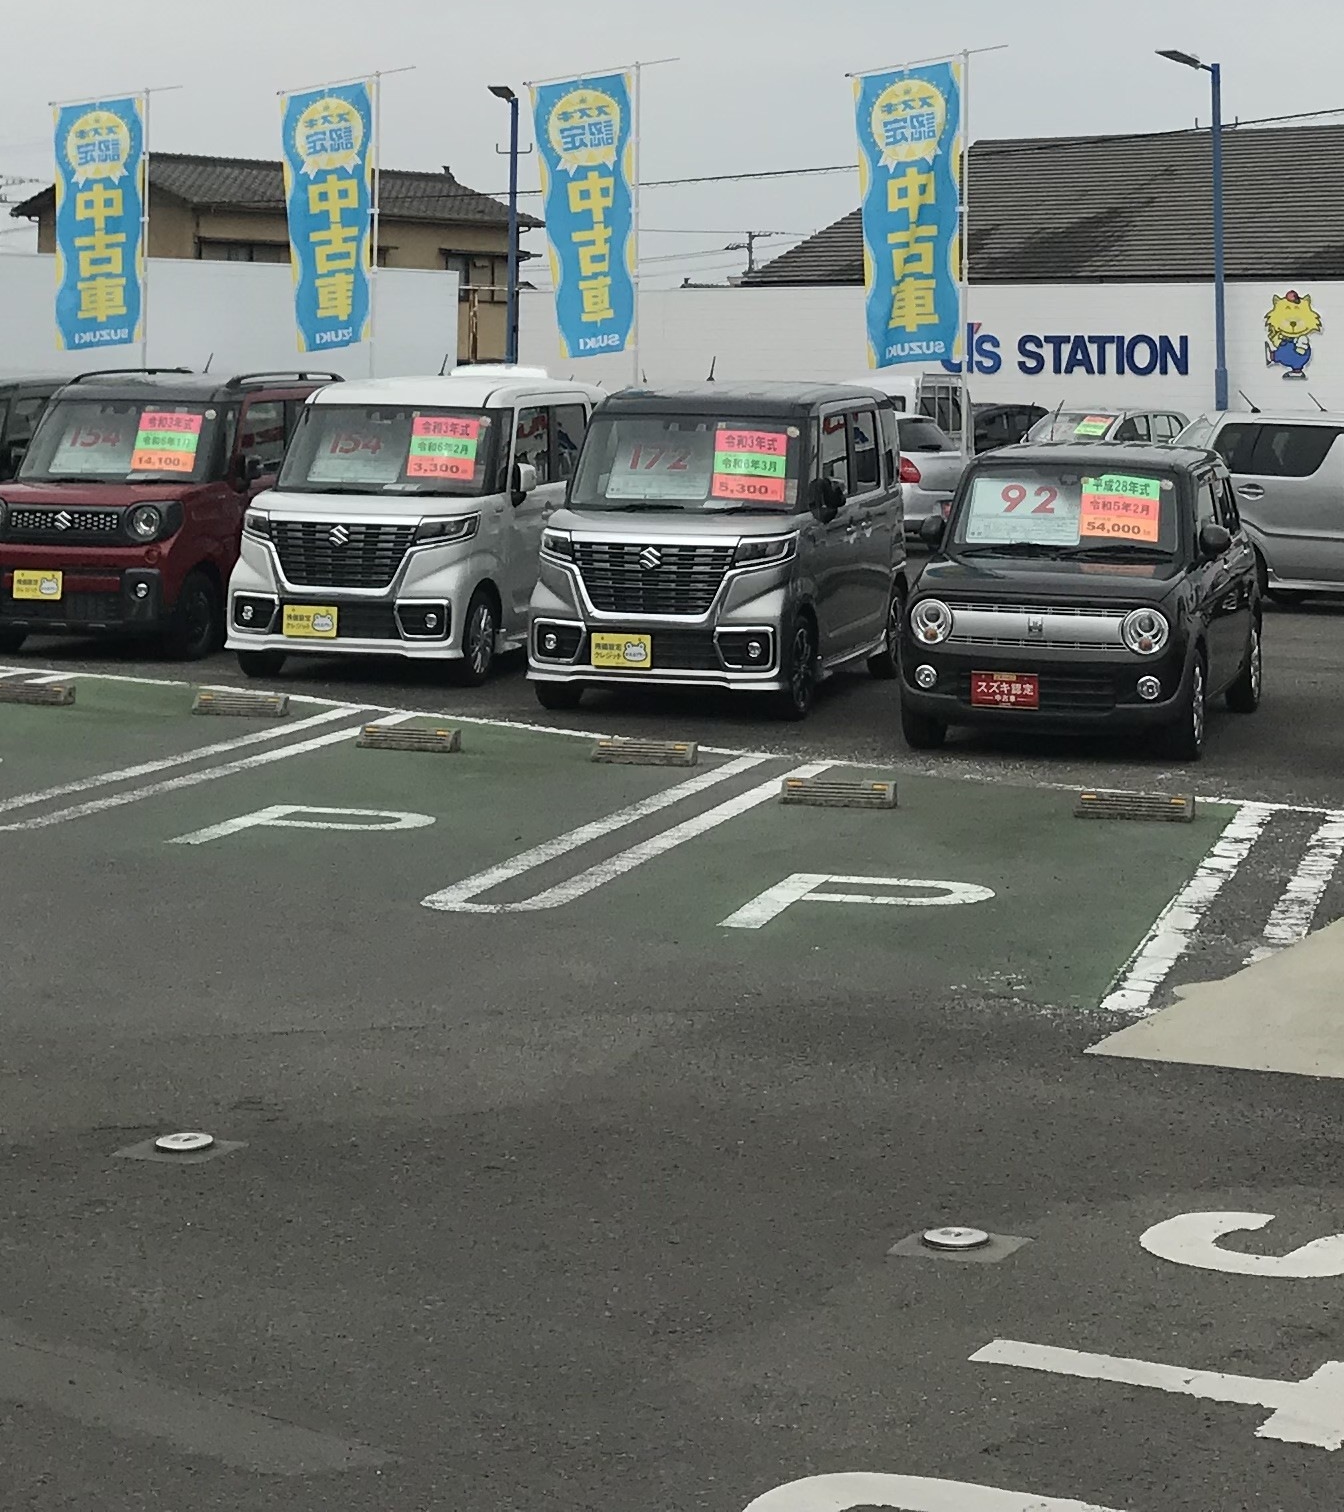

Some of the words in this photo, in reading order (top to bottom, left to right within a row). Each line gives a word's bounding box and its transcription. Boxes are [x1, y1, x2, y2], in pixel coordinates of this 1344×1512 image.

[1017, 334, 1189, 376] STATION
[422, 422, 471, 437] 令和3年式
[725, 435, 778, 453] 令和3年式
[413, 462, 460, 476] 3,300
[721, 457, 778, 474] 令和6年3月
[719, 481, 768, 496] 5,300
[1093, 478, 1151, 496] 平成28年式
[1001, 483, 1058, 514] 92
[1090, 499, 1151, 516] 令和5年2月
[1086, 520, 1141, 536] 54,000
[977, 681, 1034, 695] スズキ認定
